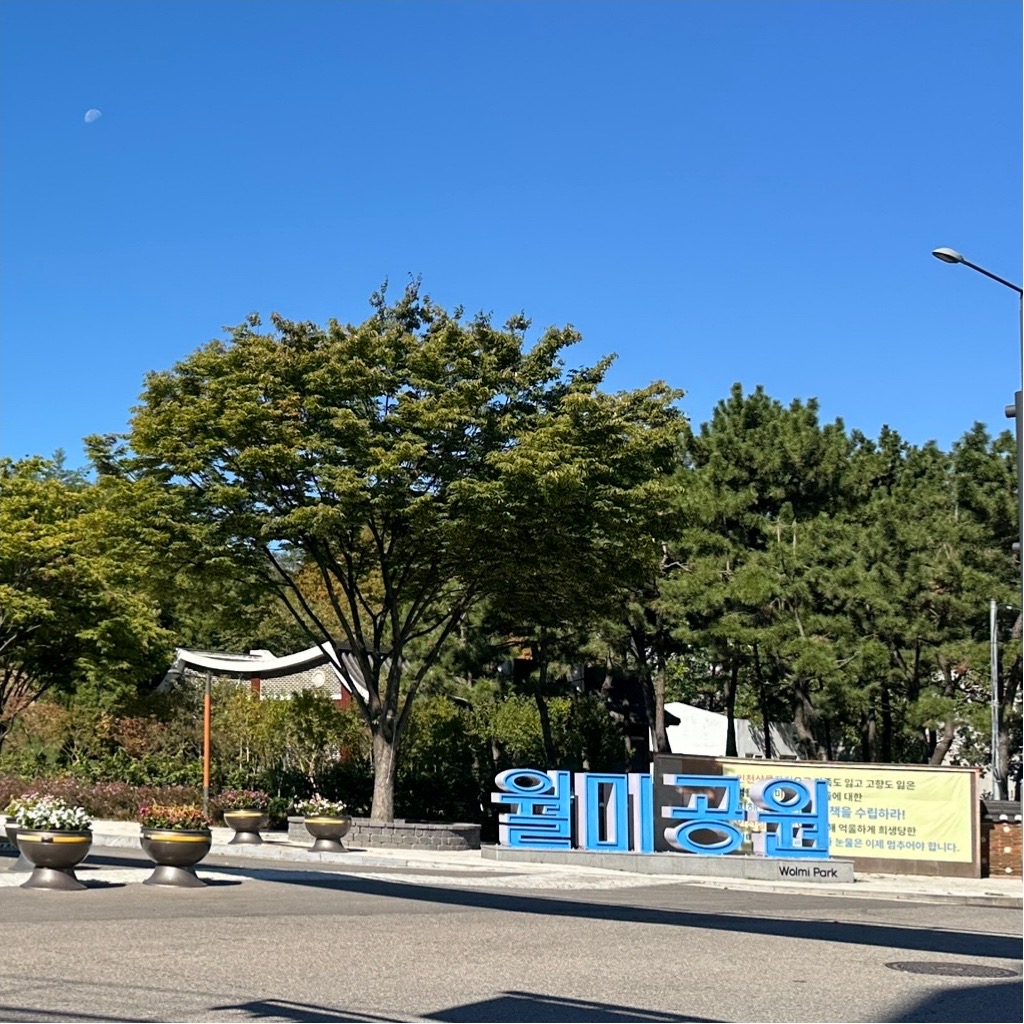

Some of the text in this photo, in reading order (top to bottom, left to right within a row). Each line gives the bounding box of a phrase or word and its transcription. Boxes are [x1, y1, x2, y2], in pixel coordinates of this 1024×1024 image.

[491, 768, 831, 859] 월미공원
[779, 865, 838, 878] Wolmi Park
